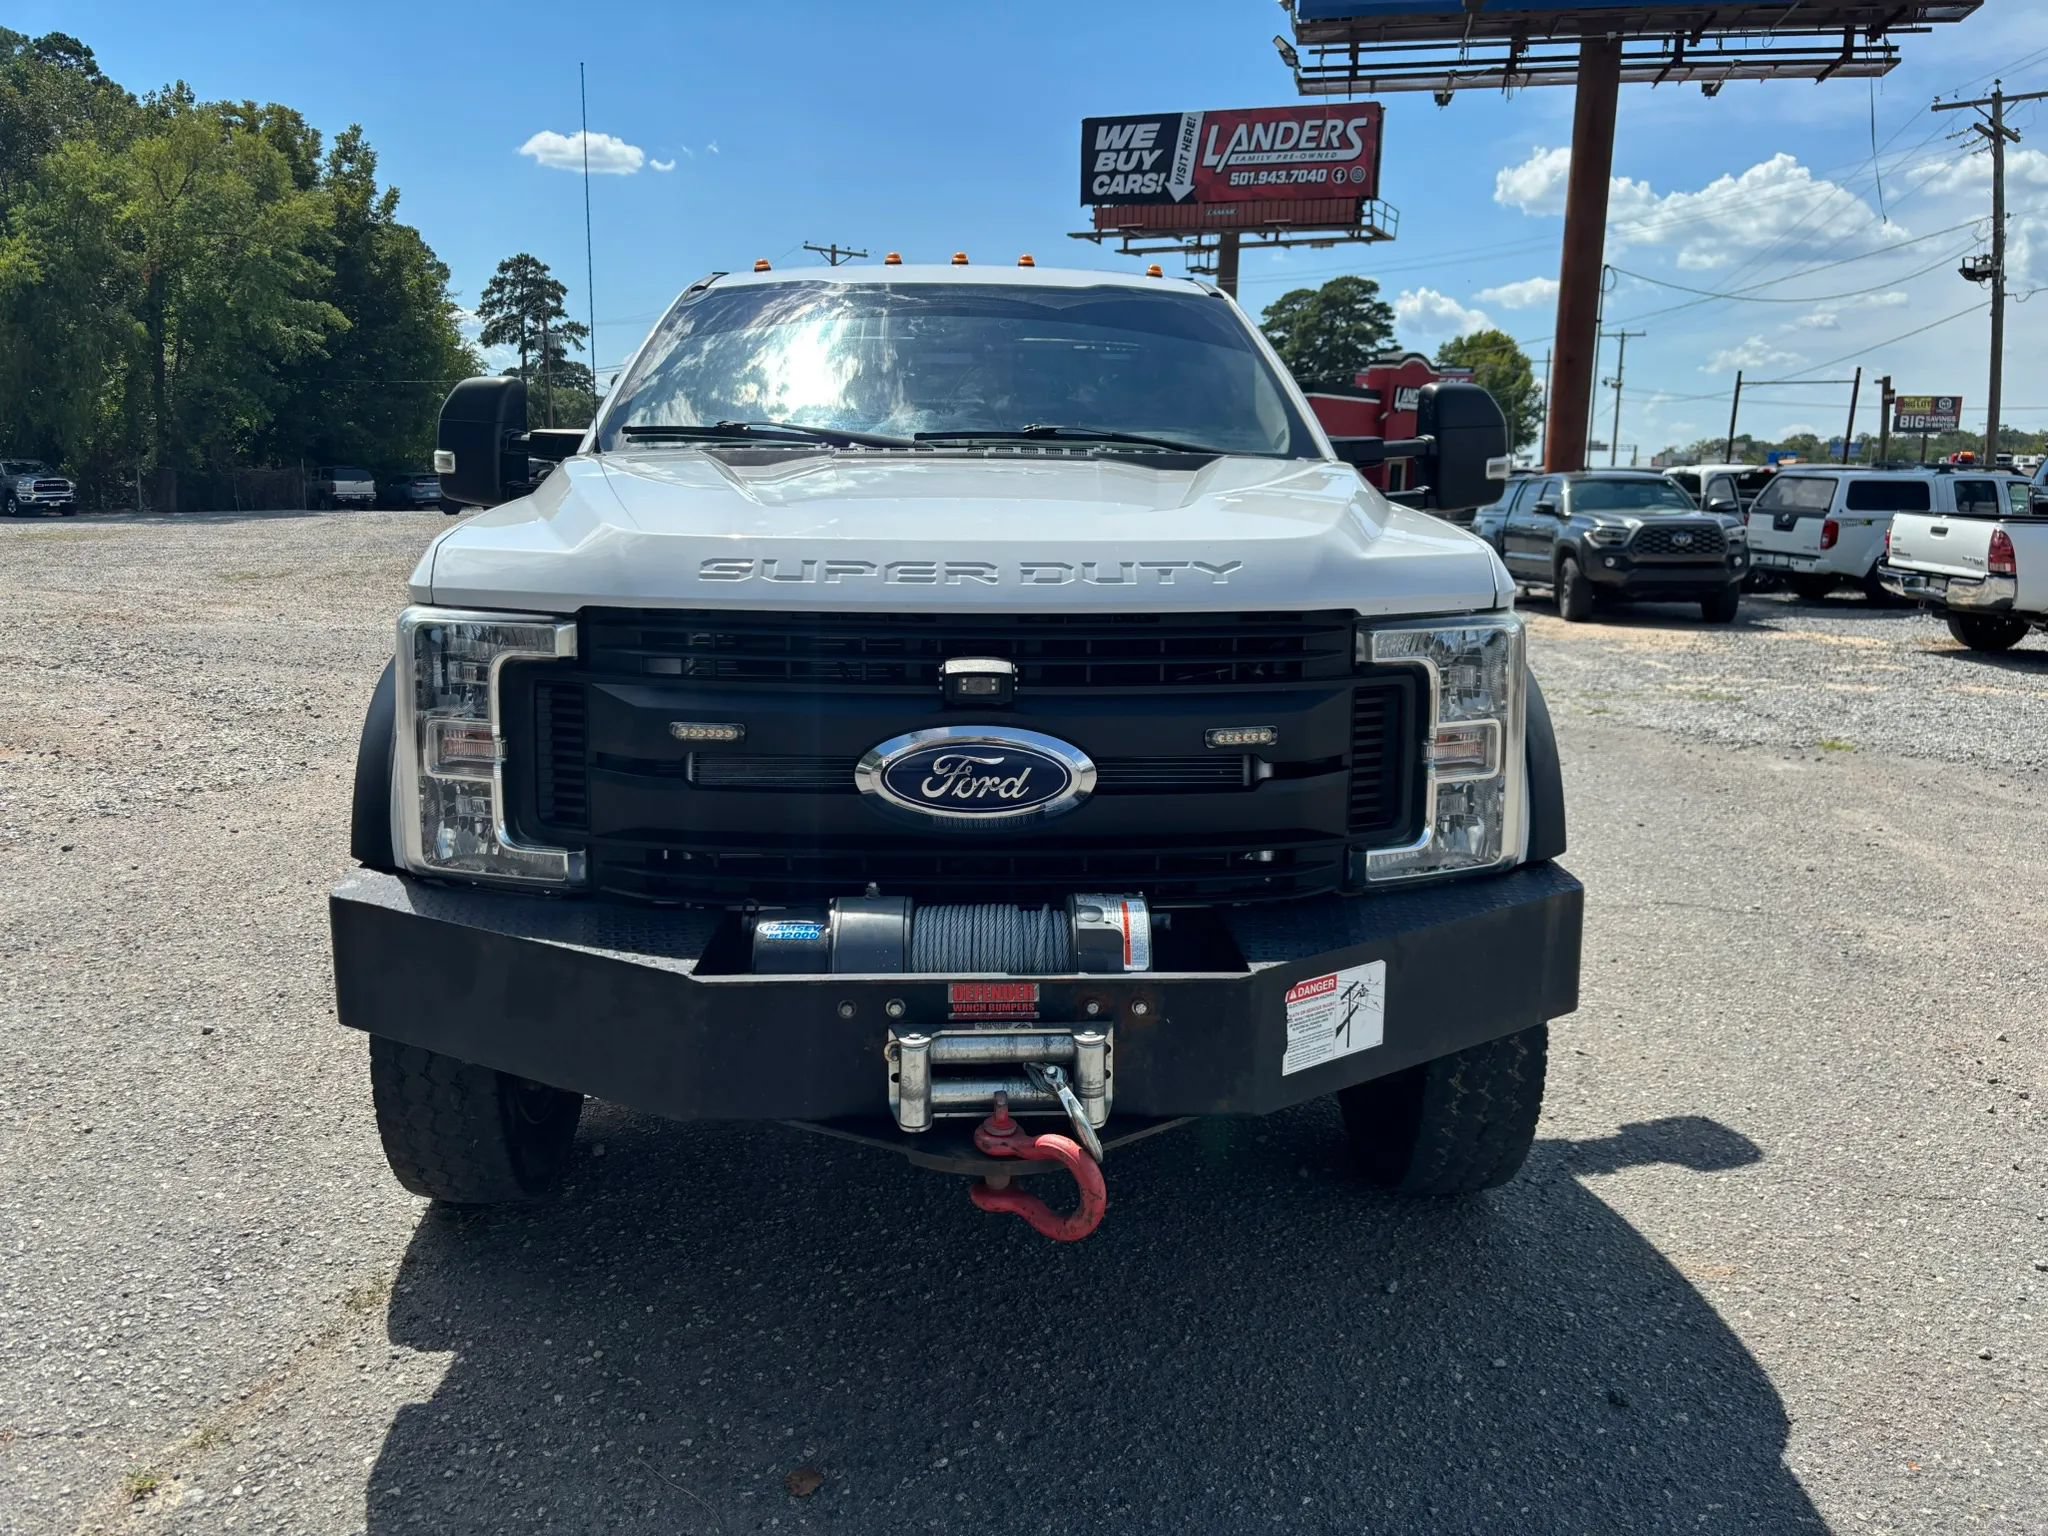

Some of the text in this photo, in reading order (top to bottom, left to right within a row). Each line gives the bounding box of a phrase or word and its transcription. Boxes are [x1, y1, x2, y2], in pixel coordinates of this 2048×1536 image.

[1095, 123, 1160, 150] WE
[1202, 117, 1368, 173] LANDERS
[1094, 149, 1163, 172] BUY
[1174, 116, 1196, 186] VISIT HERE!
[1235, 151, 1338, 163] FAMILY PRE-OWNED
[1092, 172, 1167, 196] CARS!
[1229, 168, 1328, 186] 501.943.7040
[1899, 415, 1925, 428] BIG
[698, 557, 1244, 586] SUPER DUTY
[921, 753, 1033, 798] Ford
[952, 983, 1035, 1002] DEFENDER
[1297, 978, 1335, 998] DANGER
[953, 1003, 1035, 1012] WINCH BUMPERS
